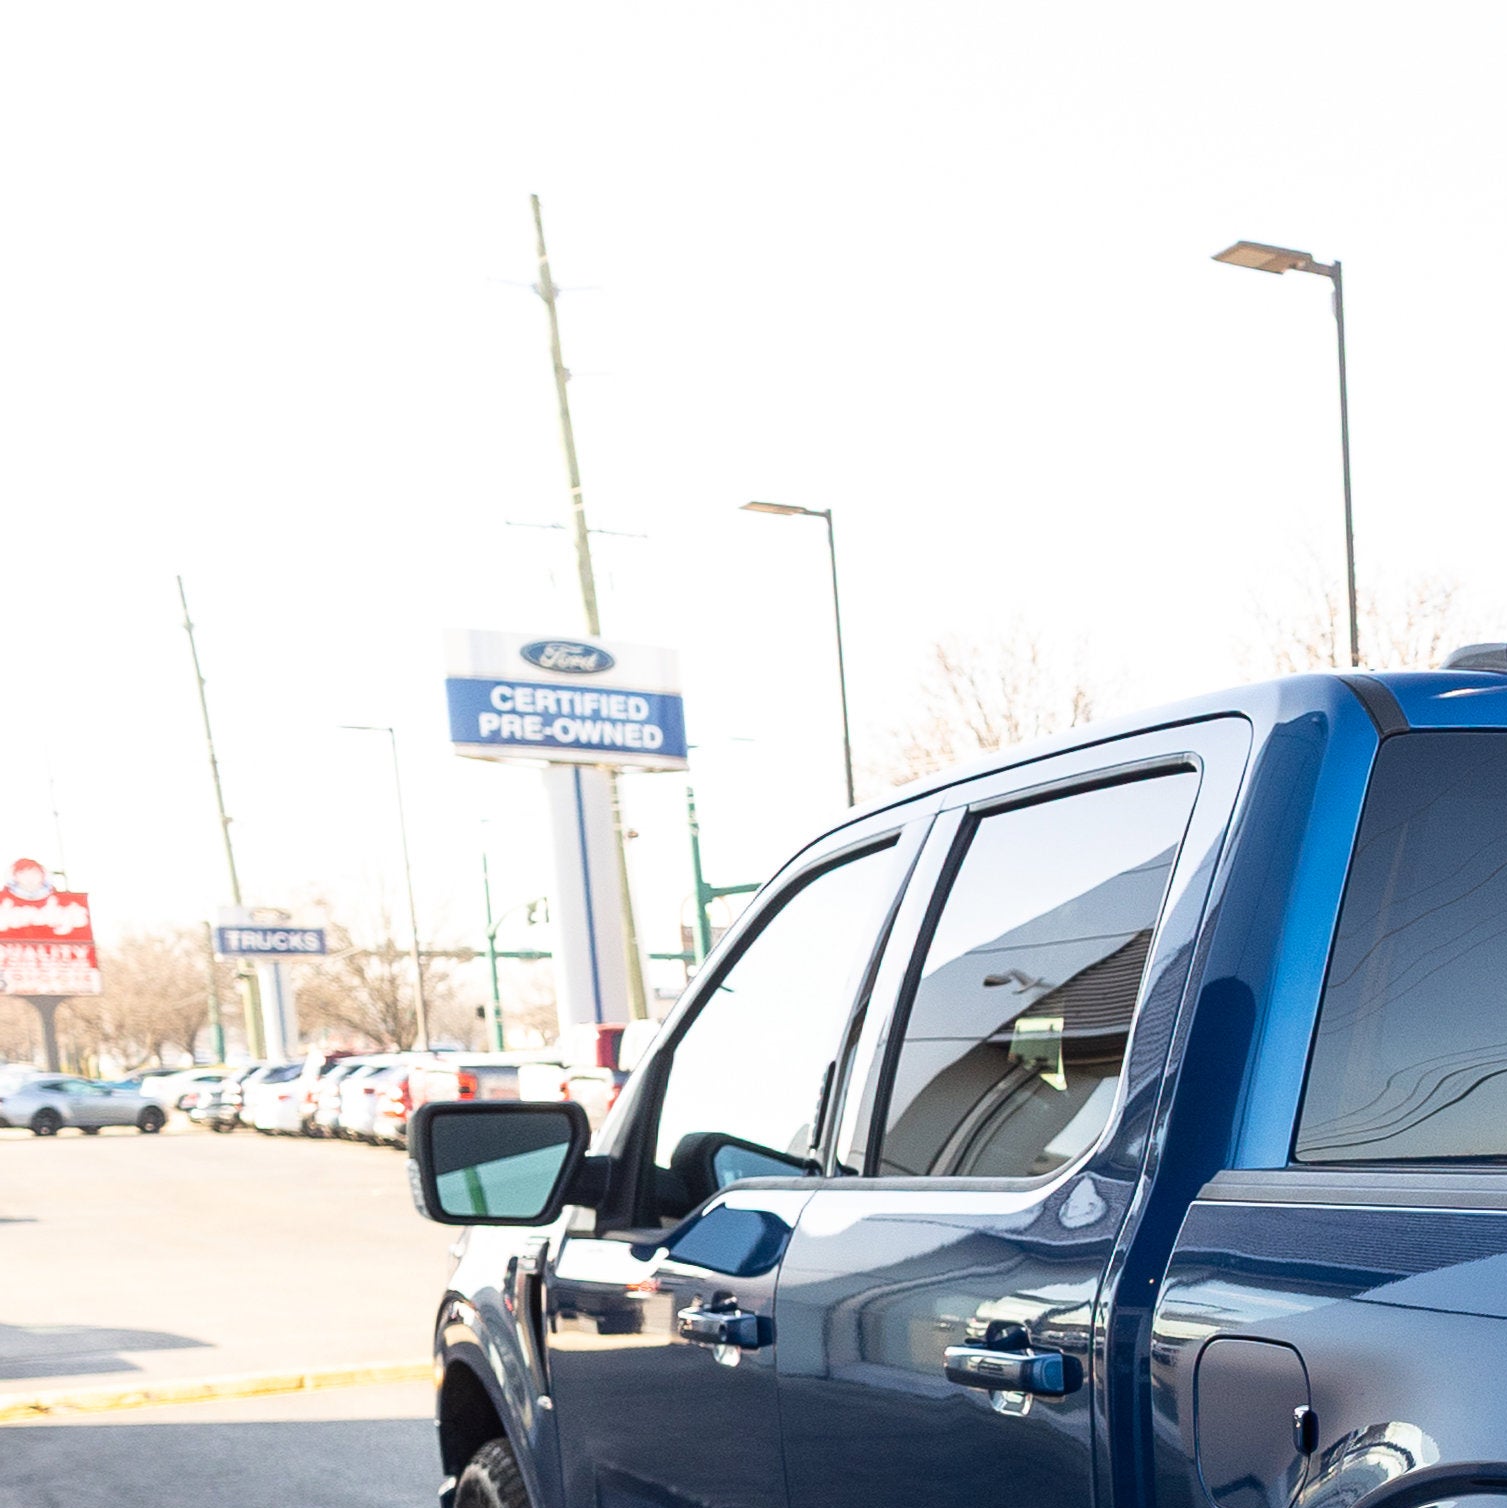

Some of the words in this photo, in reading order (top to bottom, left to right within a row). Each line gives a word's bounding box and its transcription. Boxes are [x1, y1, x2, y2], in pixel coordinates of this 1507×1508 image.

[538, 642, 600, 671] Ford
[490, 685, 650, 721] CERTIFIED
[478, 712, 664, 749] PRE-OWNED
[224, 930, 321, 951] TRUCKS
